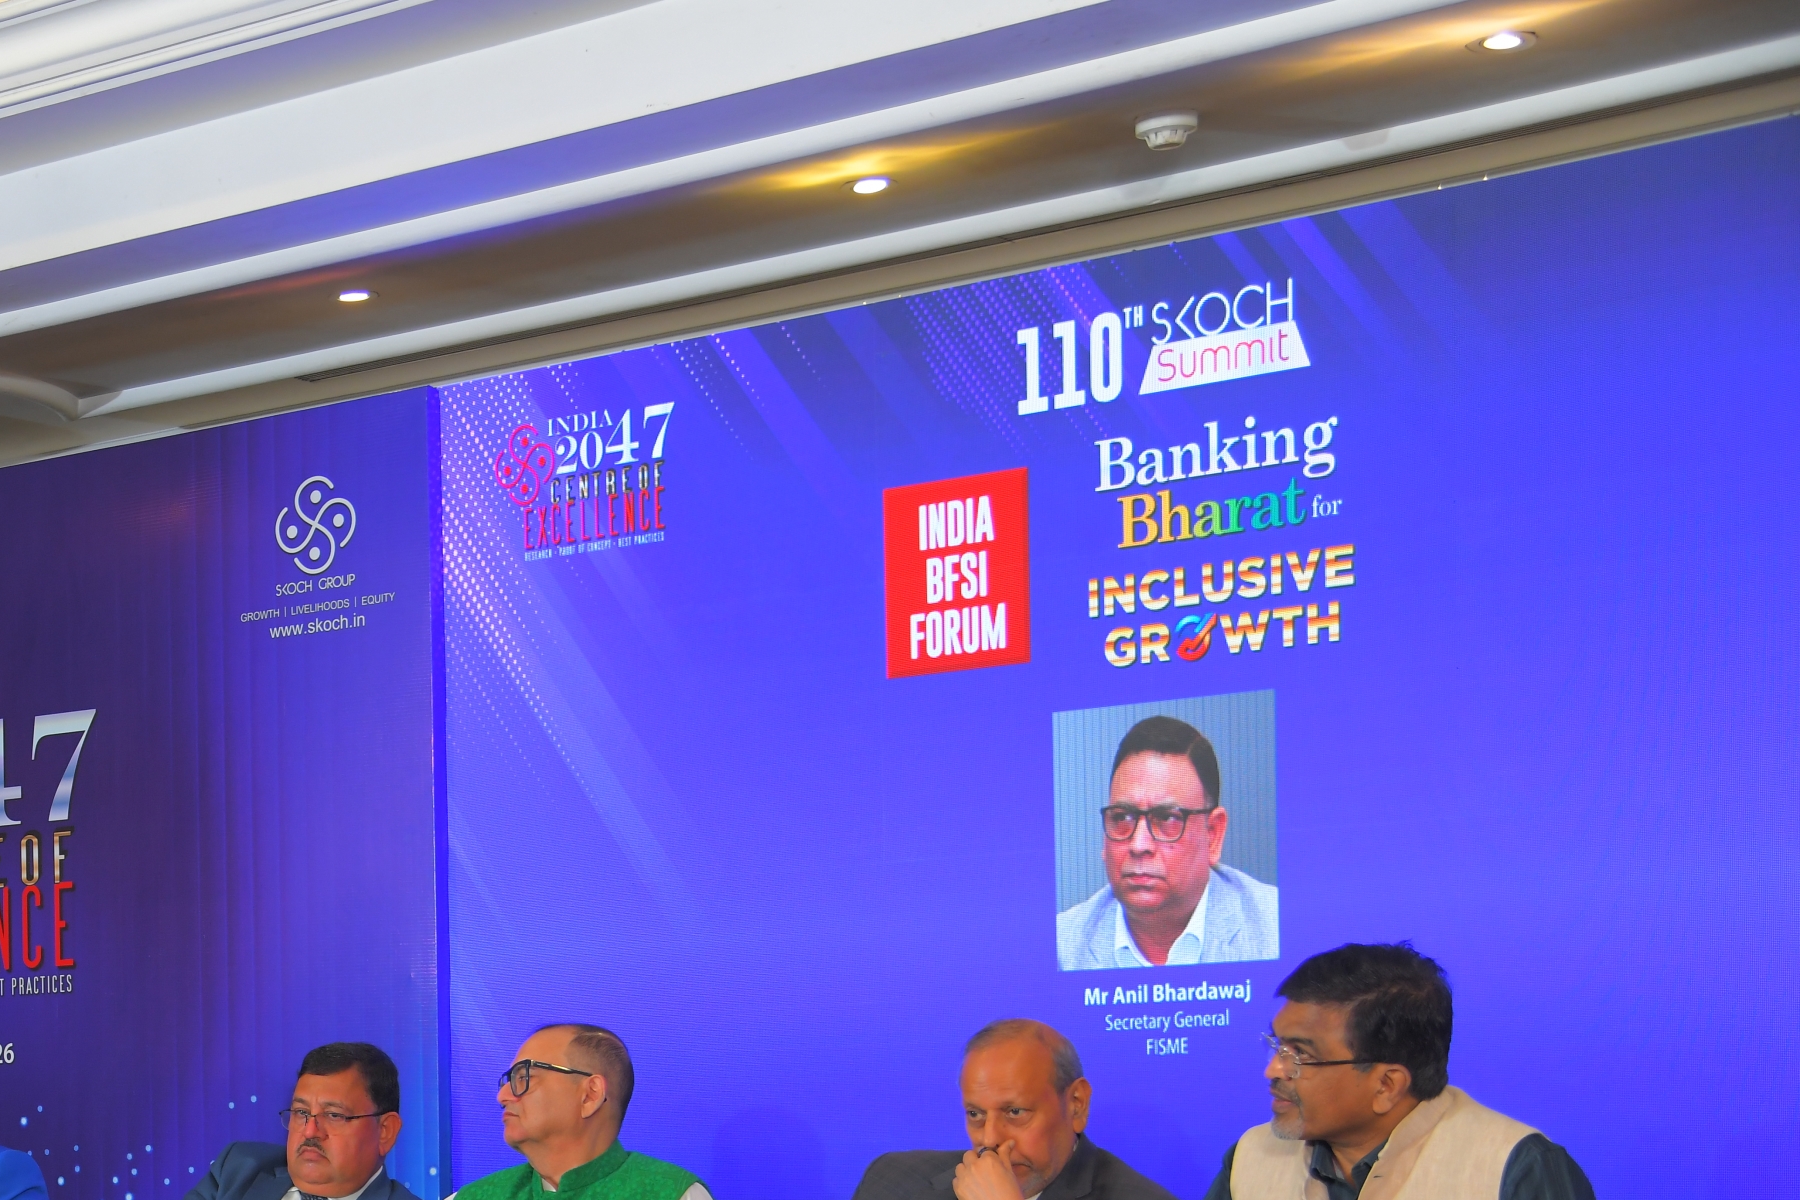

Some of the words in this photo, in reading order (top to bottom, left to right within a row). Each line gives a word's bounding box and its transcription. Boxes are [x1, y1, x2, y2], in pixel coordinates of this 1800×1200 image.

[1016, 304, 1143, 416] 110TH
[1151, 277, 1294, 345] SKOCH
[1156, 328, 1291, 382] Summit
[548, 408, 613, 437] INDIA
[555, 401, 675, 475] 2047
[1094, 416, 1338, 492] Banking
[550, 465, 632, 504] CENTRE
[638, 459, 665, 491] OF
[523, 485, 666, 549] EXCELLENCE
[918, 495, 995, 551] INDIA
[1117, 477, 1307, 549] Bharat
[1311, 494, 1343, 518] for
[524, 548, 553, 562] RESEARCH
[587, 539, 612, 552] CONCEPT
[618, 537, 632, 548] BEST
[275, 579, 313, 596] SKOCH
[318, 573, 356, 590] GROUP
[926, 550, 988, 604] BFSI
[1088, 543, 1356, 618] INCLUSIVE
[240, 608, 280, 622] GROWTH
[290, 598, 350, 616] LIVELIHOODS
[361, 592, 395, 606] EQUITY
[269, 612, 366, 639] www.skoch.in
[910, 602, 1007, 660] FORUM
[20, 830, 73, 885] OF
[11, 974, 73, 996] PRACTICES
[1084, 987, 1109, 1006] Mr
[1112, 984, 1148, 1004] Anil
[1152, 979, 1251, 1003] Bhardawaj
[1105, 1013, 1171, 1033] Secretary
[1174, 1008, 1230, 1028] General
[1146, 1037, 1189, 1056] FISME
